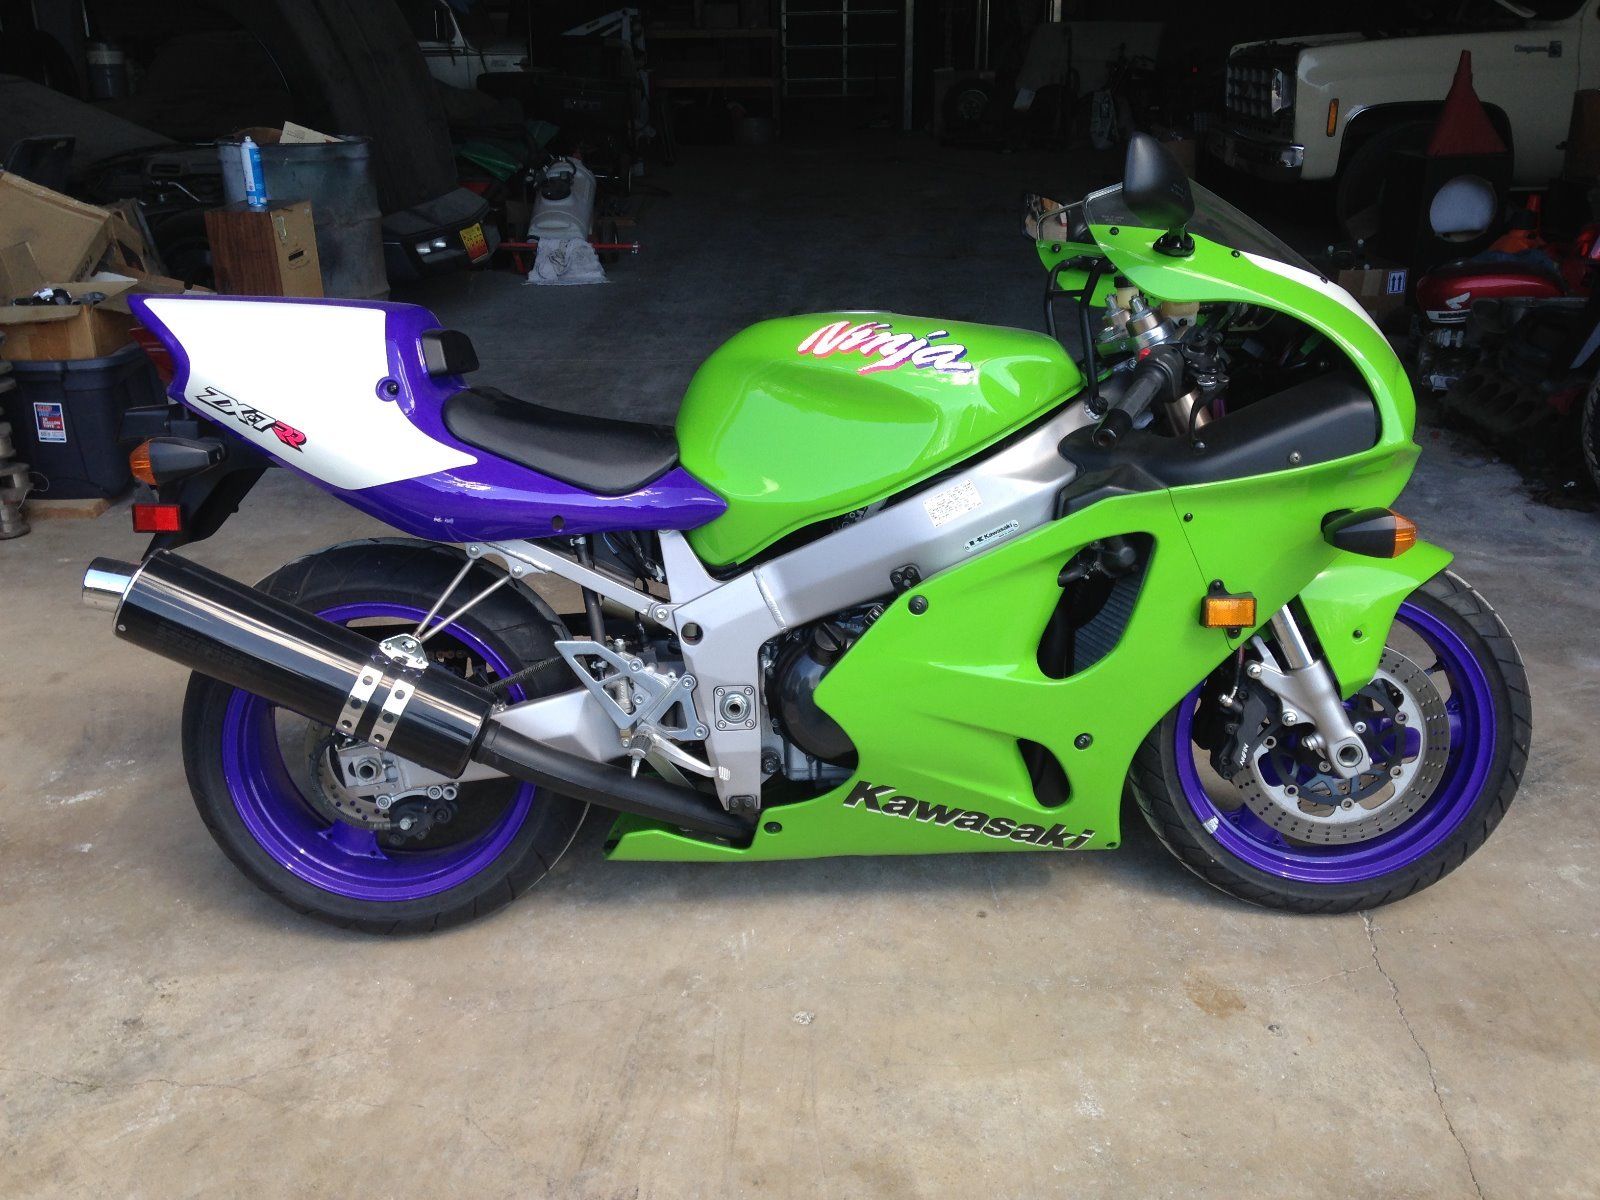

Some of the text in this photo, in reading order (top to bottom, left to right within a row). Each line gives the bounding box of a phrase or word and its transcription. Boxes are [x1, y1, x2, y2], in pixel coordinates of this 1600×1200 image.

[797, 321, 974, 376] Ninja
[984, 522, 1013, 540] Kawasaki
[843, 780, 1095, 850] Kawasaki
